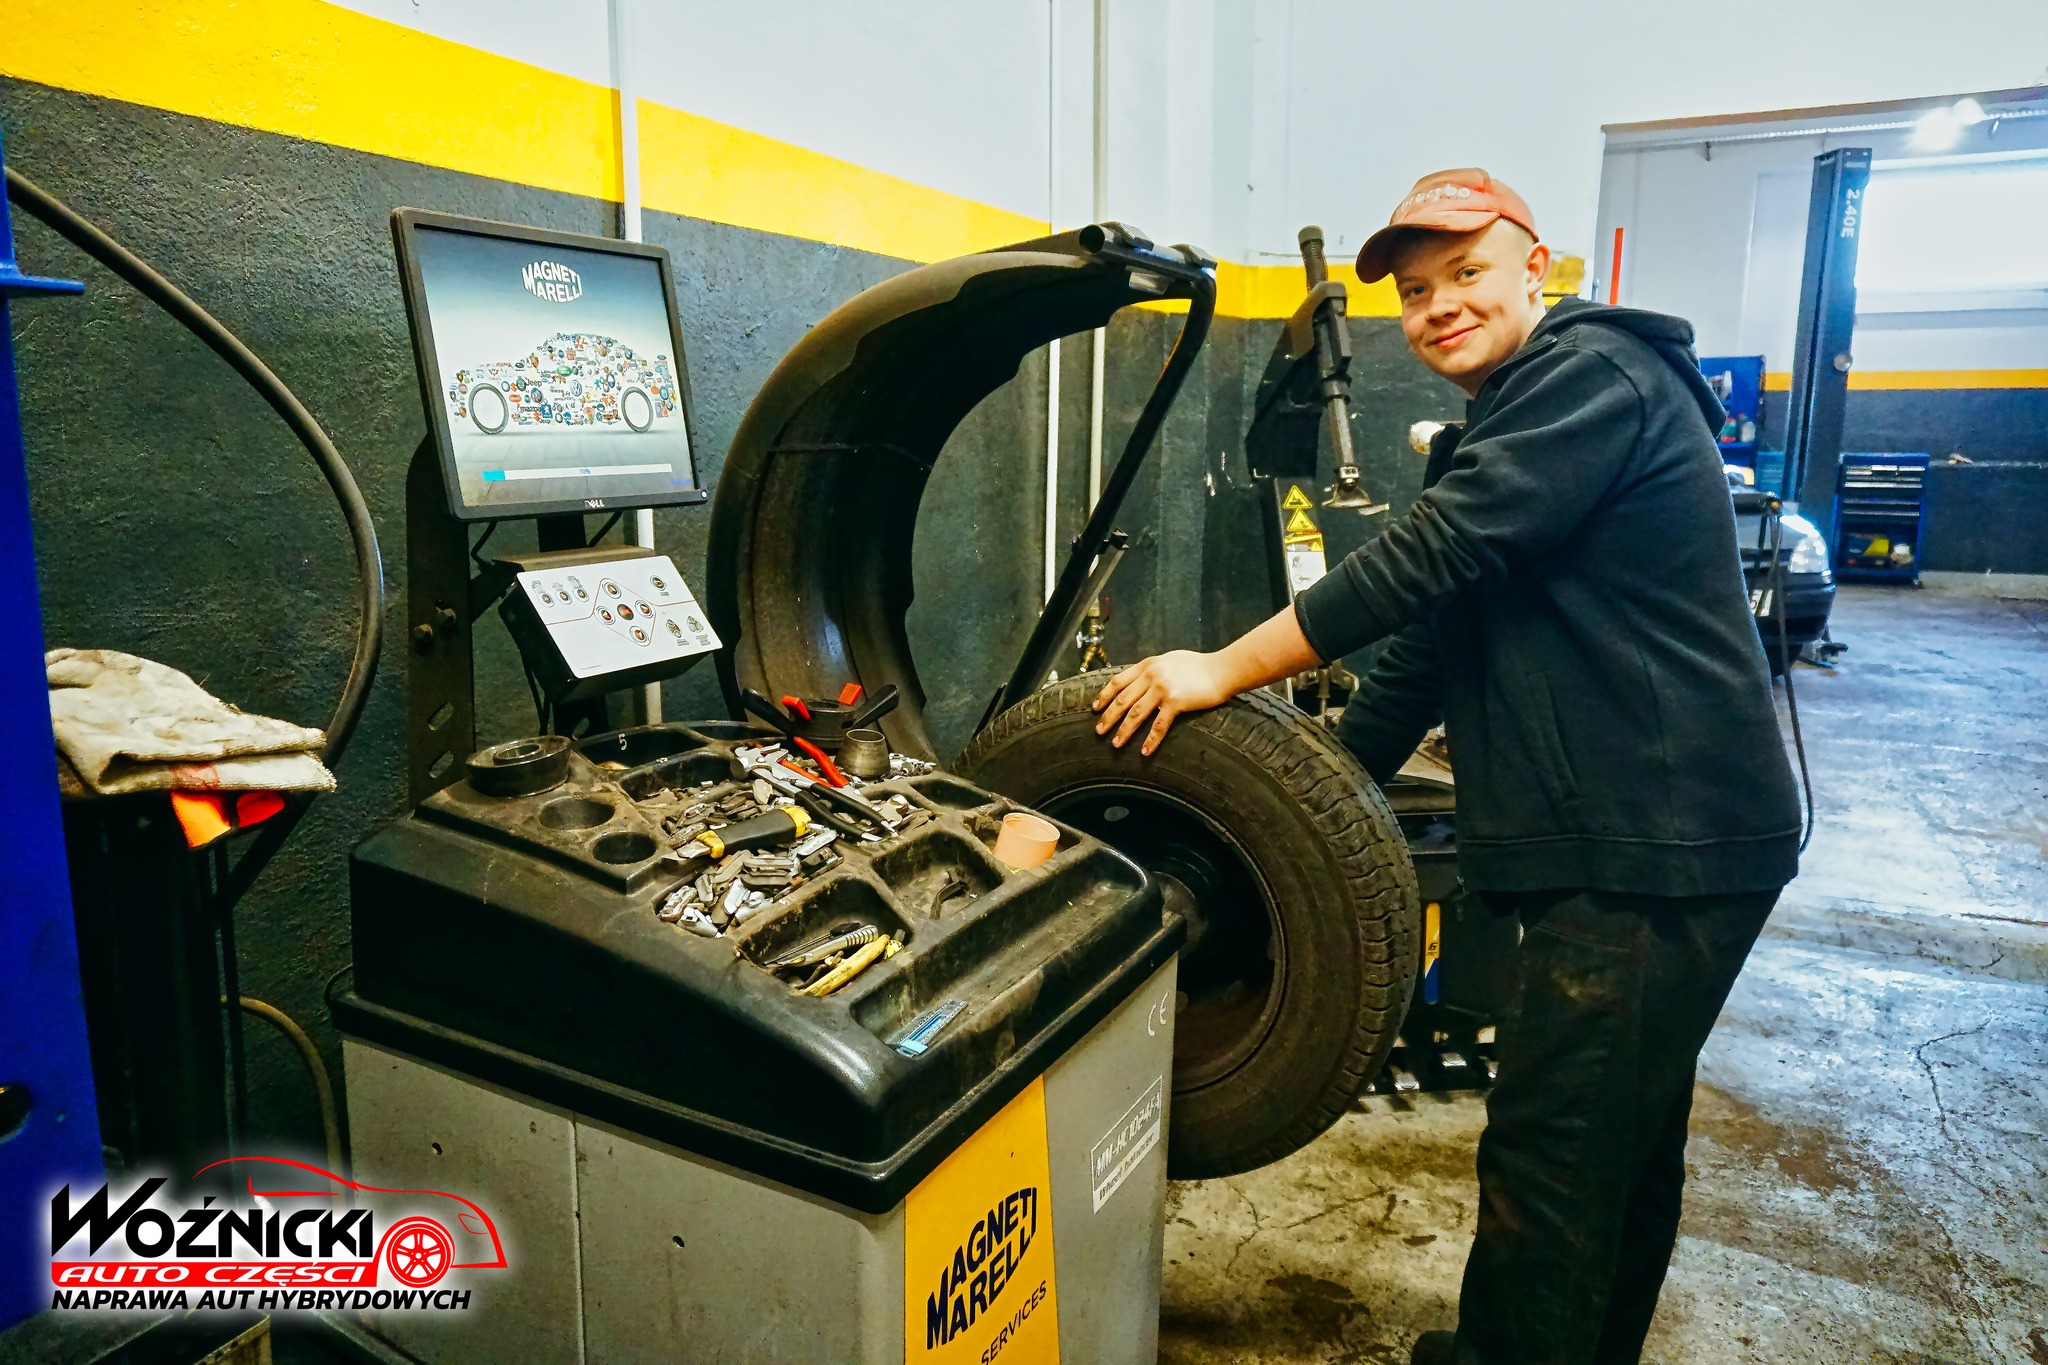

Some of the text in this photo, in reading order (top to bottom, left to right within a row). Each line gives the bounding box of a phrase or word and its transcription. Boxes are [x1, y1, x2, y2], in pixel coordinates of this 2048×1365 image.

[1841, 188, 1860, 238] 2.40E
[521, 260, 581, 288] MAGNETI
[522, 274, 583, 303] MARELLI
[584, 499, 605, 509] DELL
[926, 1187, 1038, 1324] MAGNETI
[926, 1212, 1038, 1350] MARELLI
[981, 1279, 1047, 1365] SERVICES
